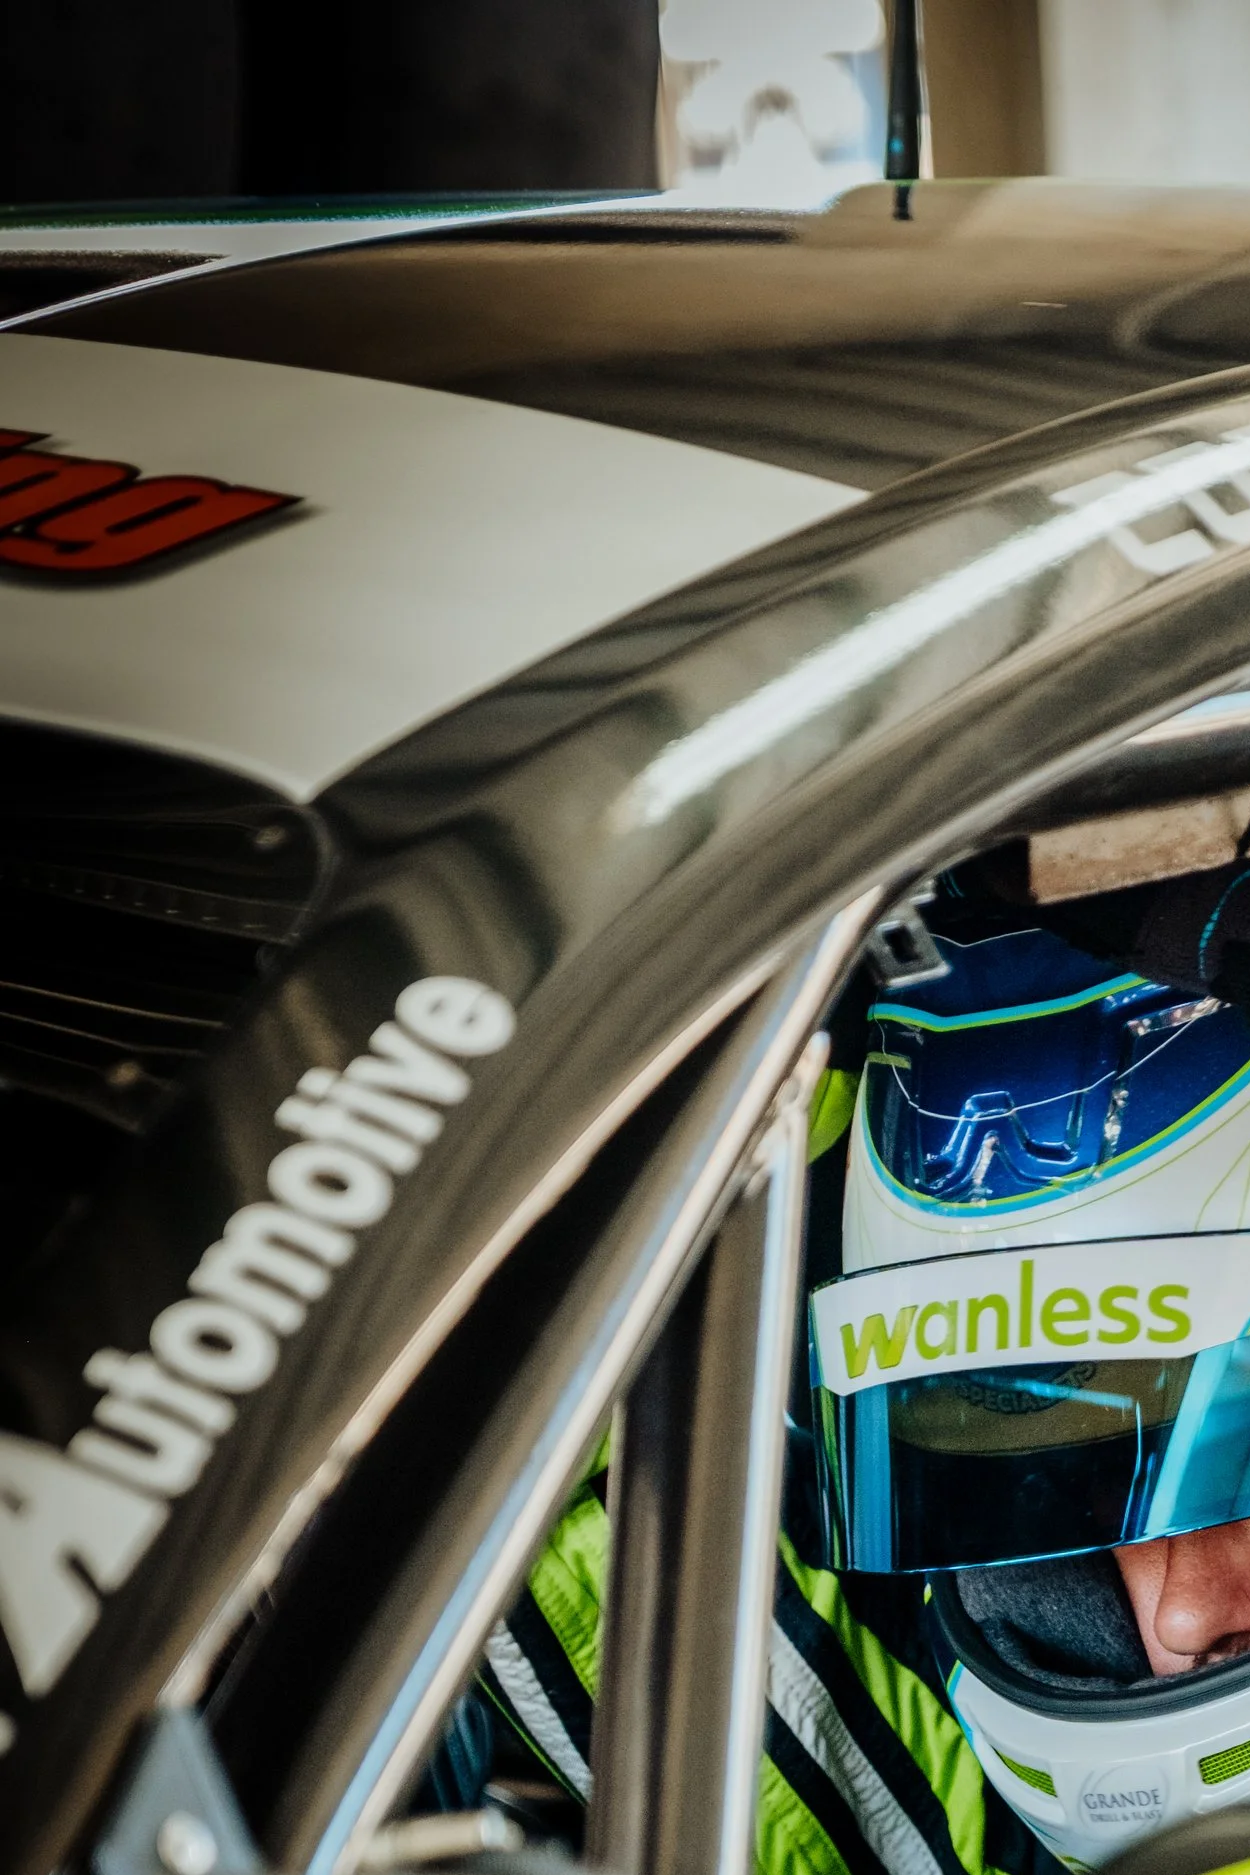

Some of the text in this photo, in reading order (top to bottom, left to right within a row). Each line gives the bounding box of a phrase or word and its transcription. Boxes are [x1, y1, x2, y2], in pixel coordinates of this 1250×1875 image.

[0, 976, 516, 1698] Automotive
[839, 1259, 1192, 1379] wanless
[1083, 1788, 1162, 1810] GRANDE
